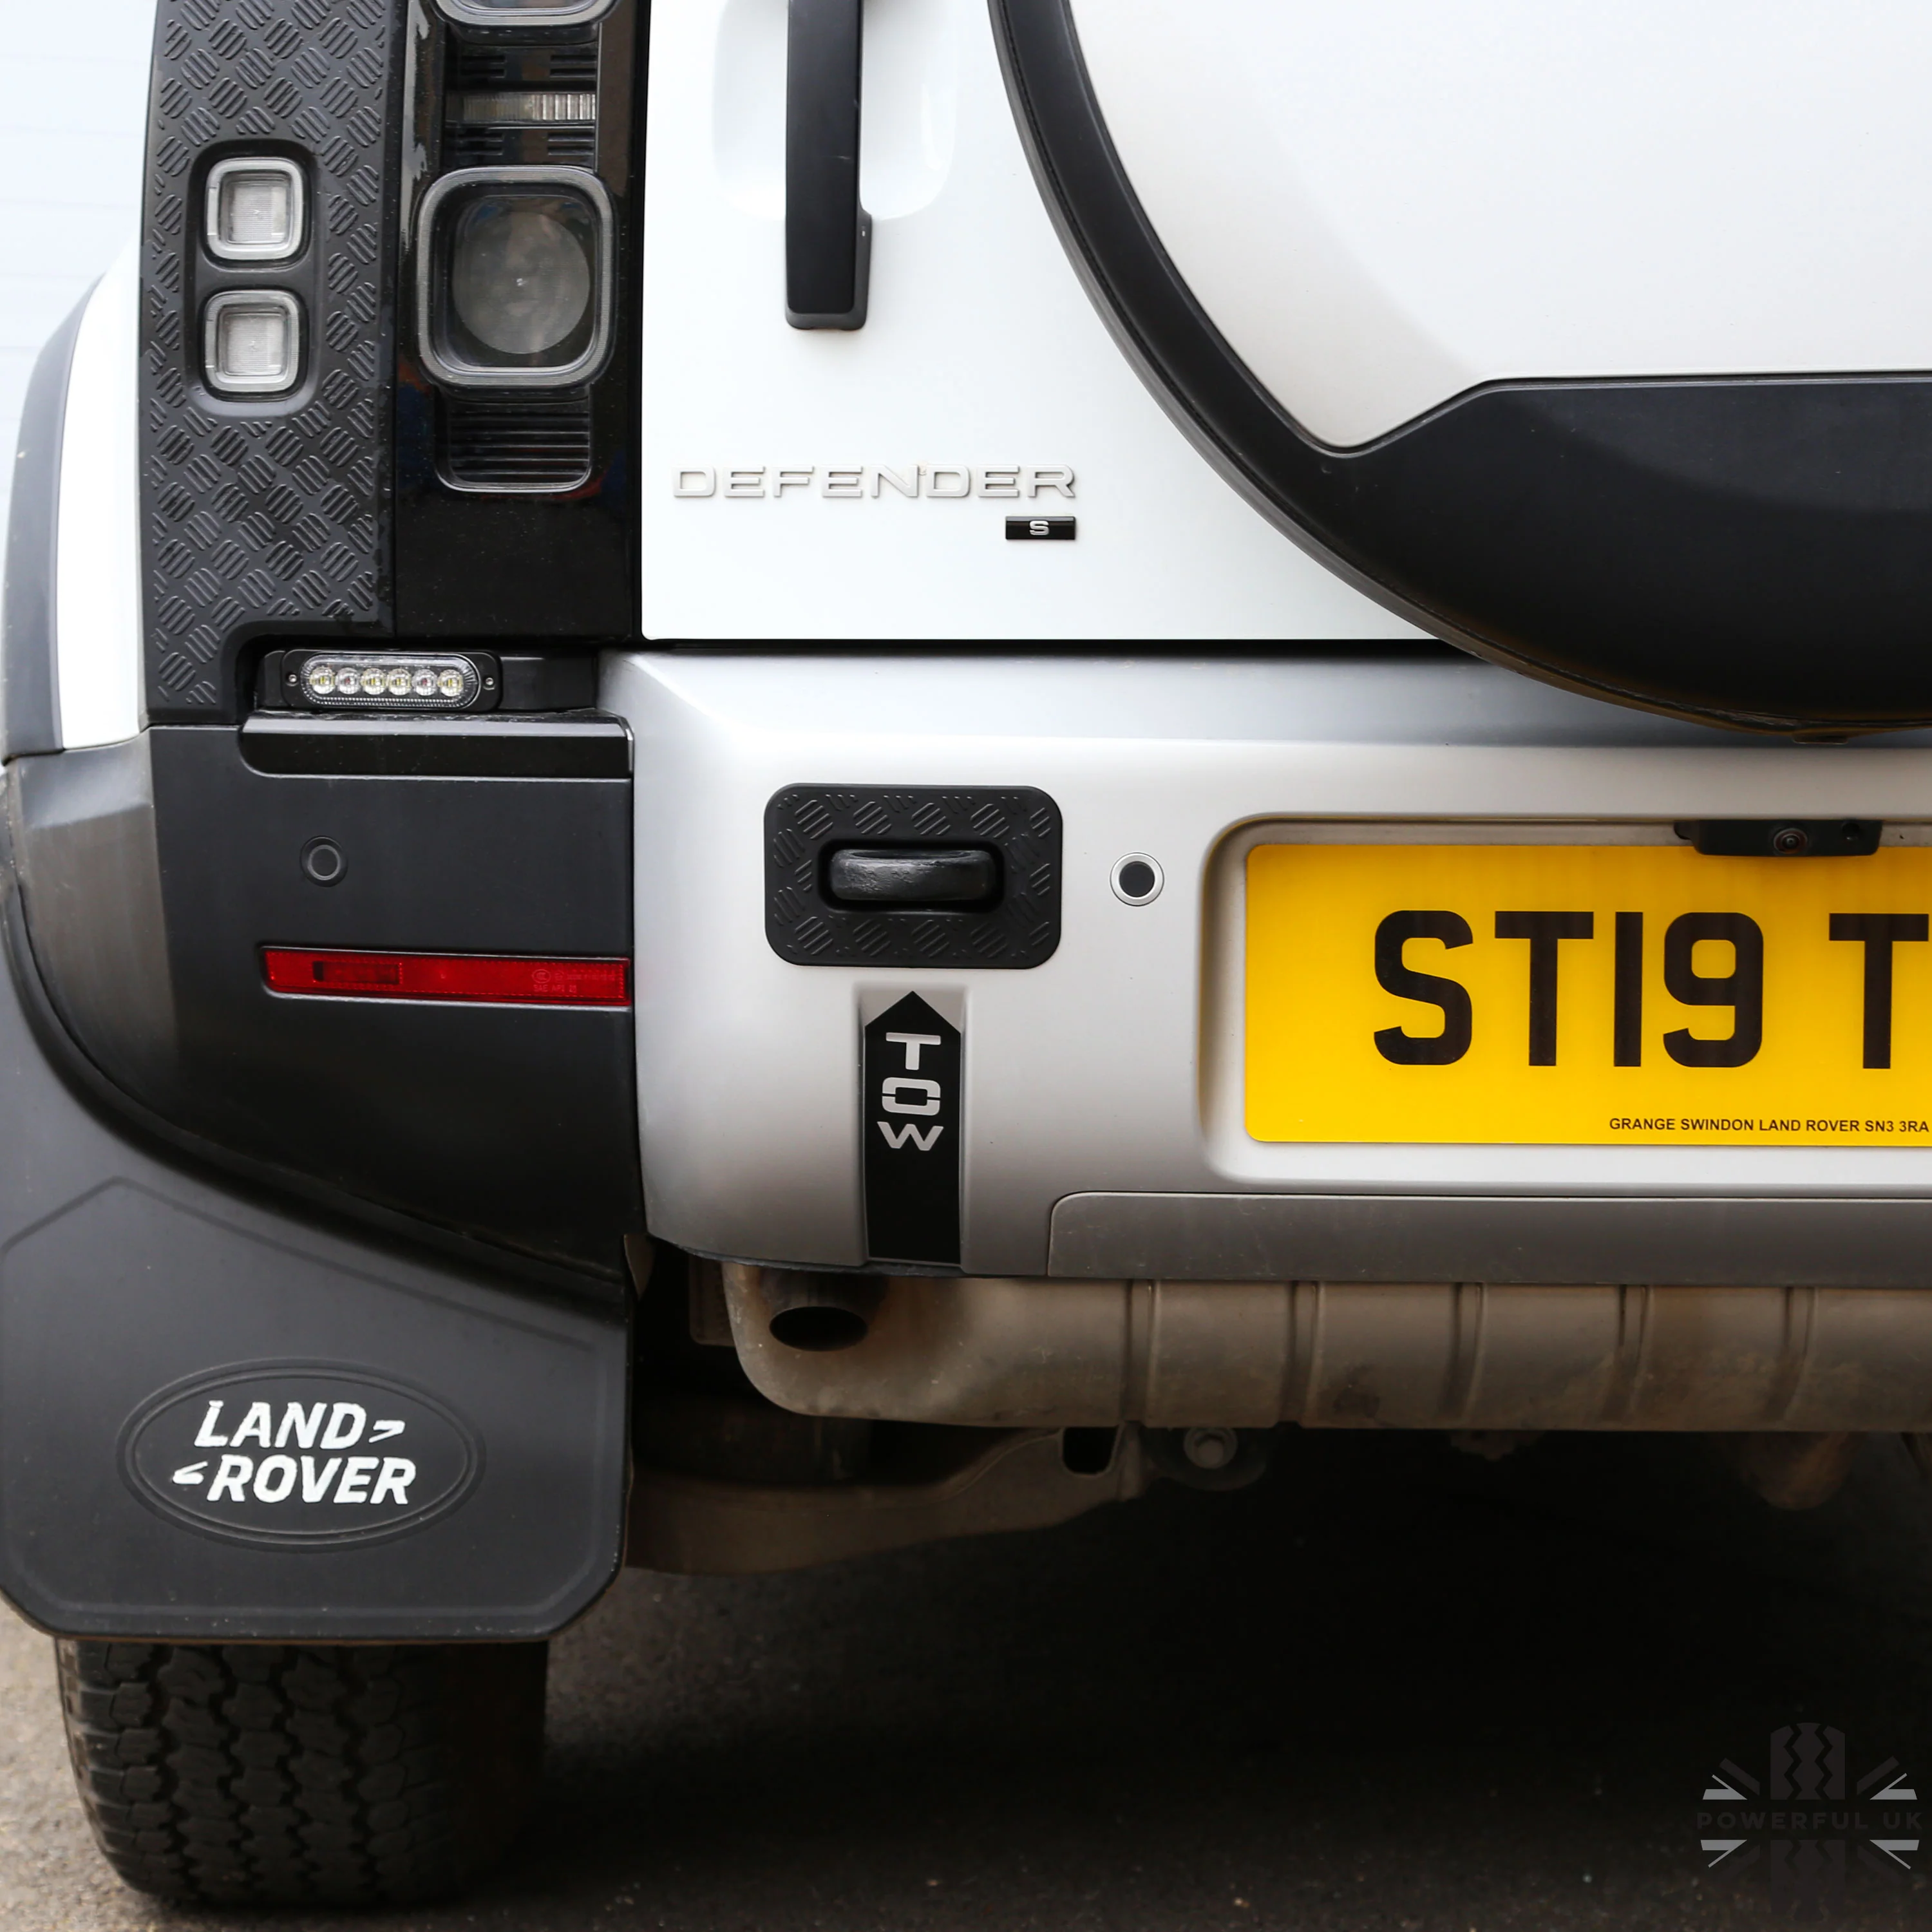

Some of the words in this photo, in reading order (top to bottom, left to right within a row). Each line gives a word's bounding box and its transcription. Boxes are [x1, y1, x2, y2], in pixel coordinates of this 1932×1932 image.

[673, 464, 1075, 498] DEFENDER
[1028, 520, 1050, 536] S
[1374, 910, 1763, 1068] ST19
[1828, 912, 1929, 1070] T
[876, 1032, 944, 1151] TOW
[1609, 1117, 1676, 1130] GRANGE
[1680, 1118, 1754, 1131] SWINDON
[1759, 1119, 1801, 1132] LAND
[1806, 1119, 1860, 1132] ROVER
[1864, 1120, 1894, 1132] SN3
[1899, 1121, 1929, 1133] 3RA
[194, 1399, 367, 1450] LAND
[206, 1454, 417, 1505] ROVER
